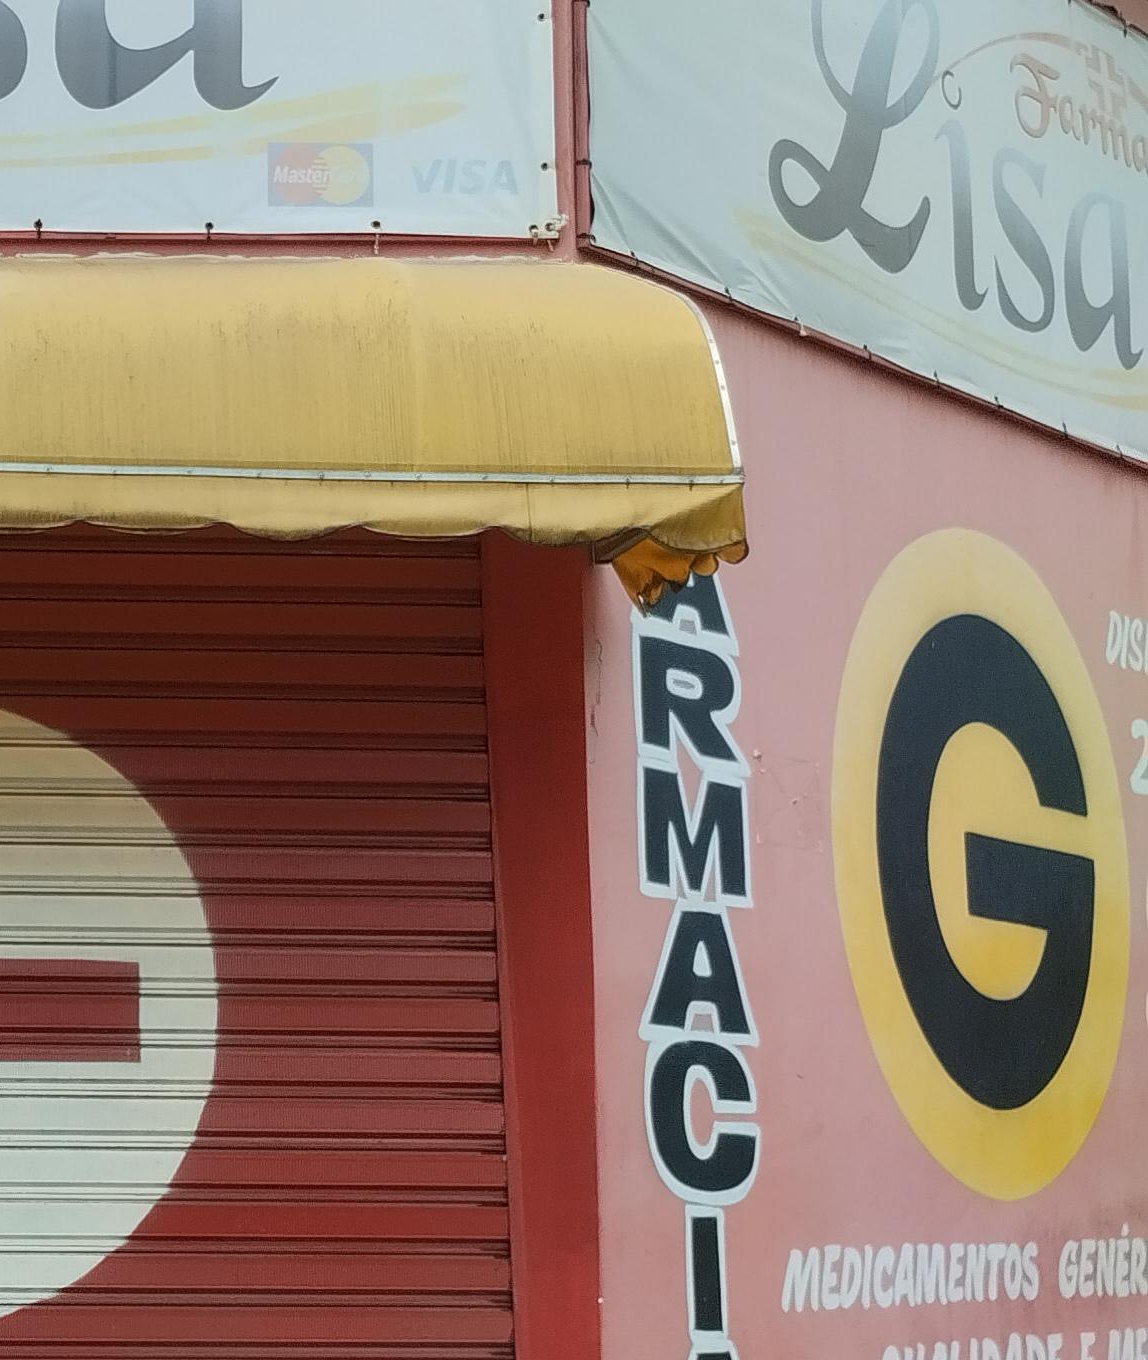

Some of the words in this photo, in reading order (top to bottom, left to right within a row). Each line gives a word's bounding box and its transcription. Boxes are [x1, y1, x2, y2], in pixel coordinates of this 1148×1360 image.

[412, 158, 520, 195] VISA
[1106, 610, 1148, 675] DIS
[876, 613, 1095, 1111] G
[781, 1242, 1039, 1313] MEDICAMENTOS
